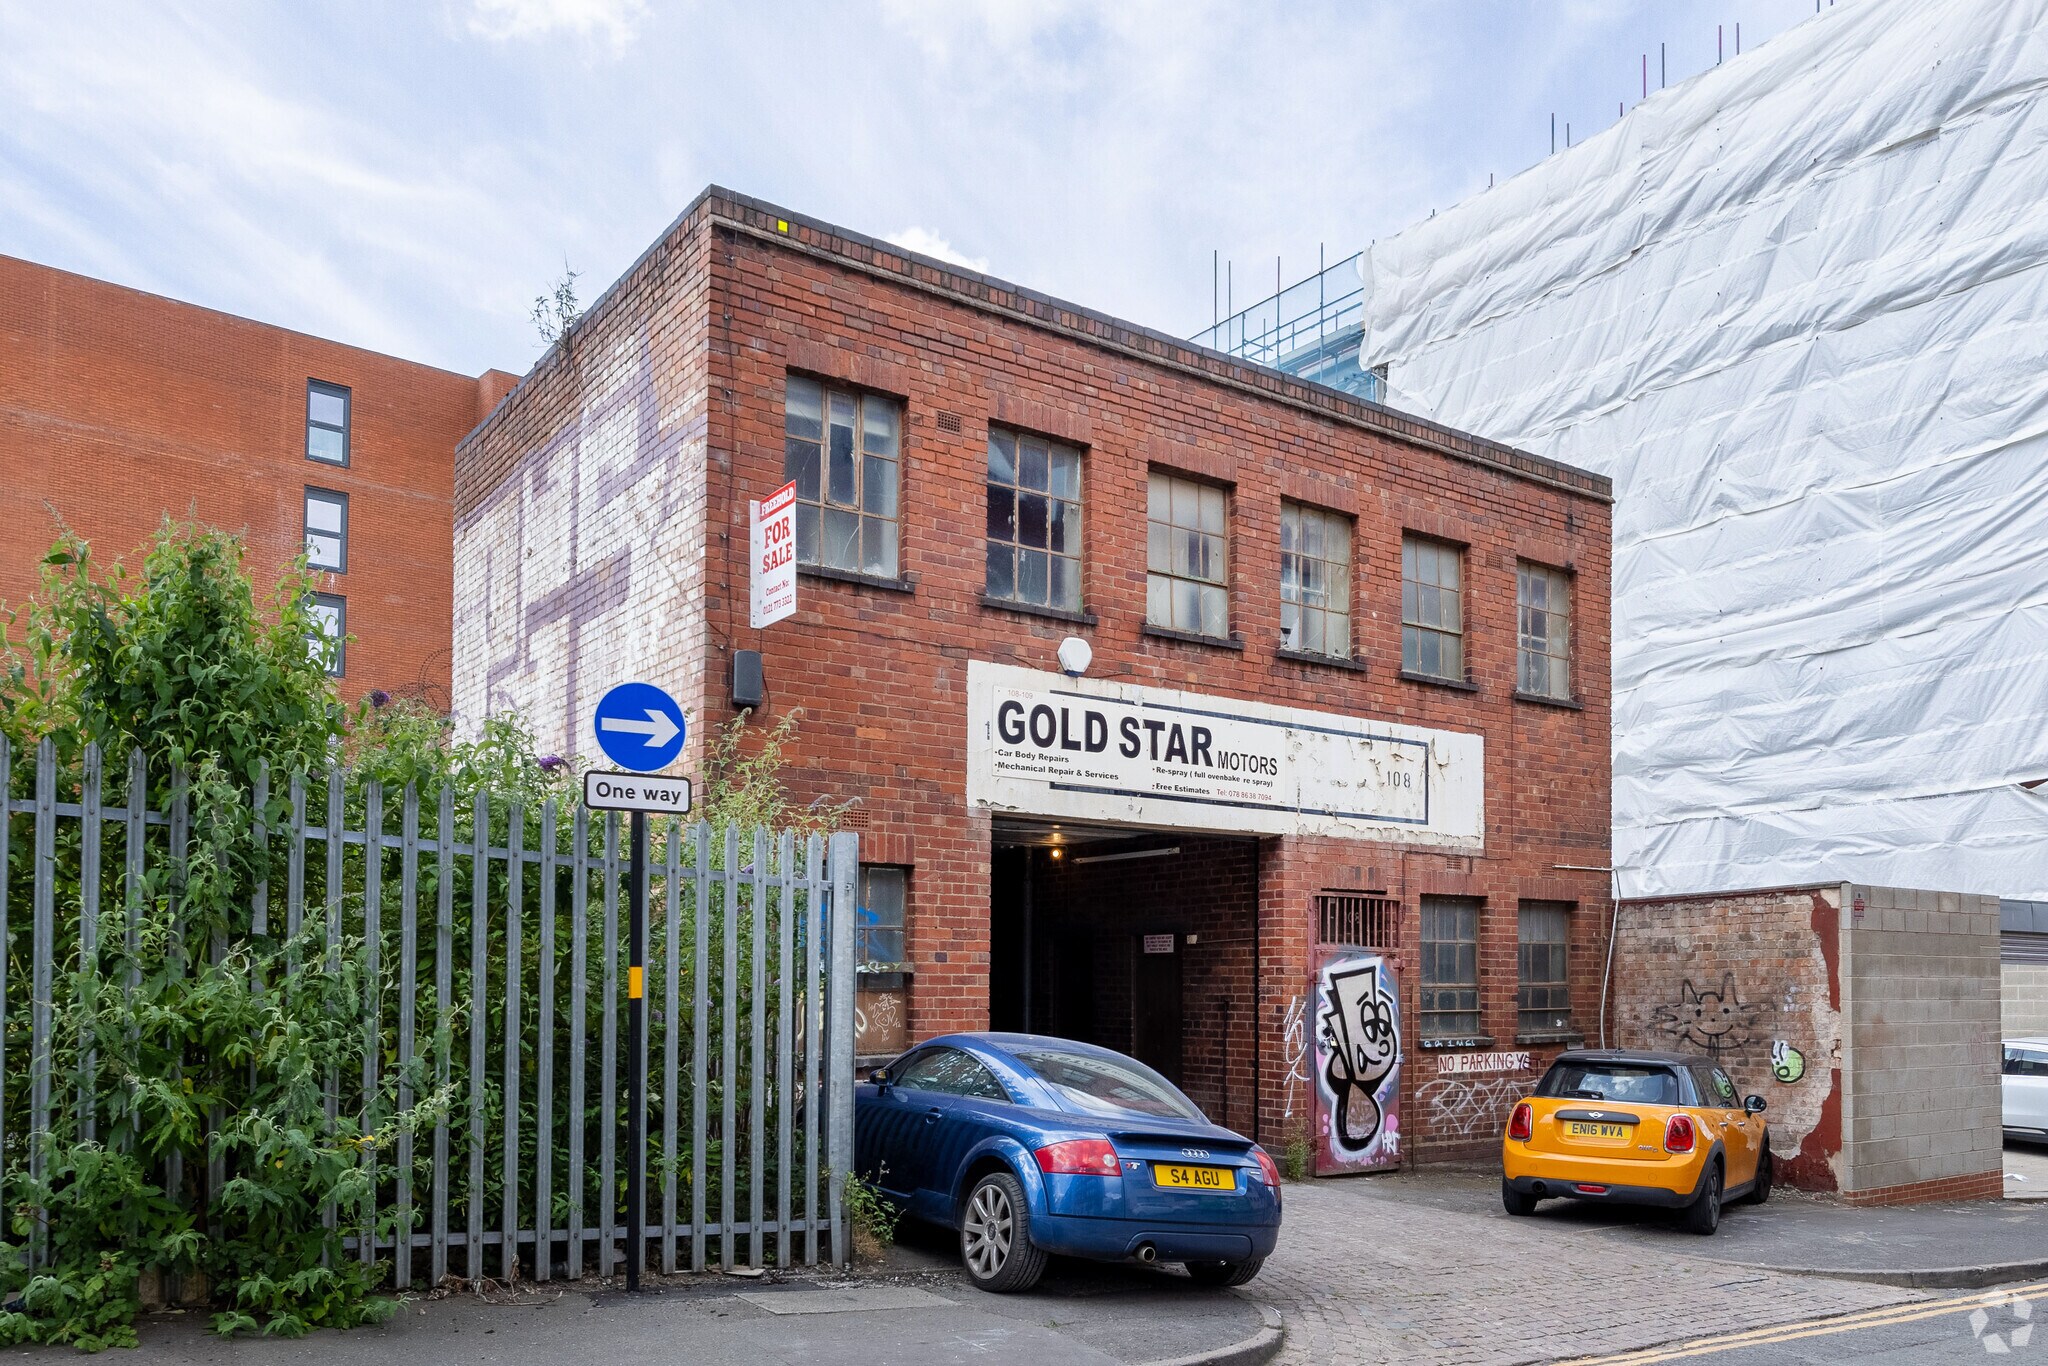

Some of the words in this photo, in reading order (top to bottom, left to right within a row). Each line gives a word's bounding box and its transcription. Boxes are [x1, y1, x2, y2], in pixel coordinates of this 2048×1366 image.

[764, 516, 791, 549] FOR
[762, 542, 793, 574] SALE
[1007, 689, 1034, 700] 108-109
[997, 700, 1109, 753] GOLD
[1118, 716, 1215, 768] STAR
[1217, 750, 1278, 776] MOTORS
[1015, 750, 1036, 761] Body
[1038, 753, 1070, 764] Repairs
[997, 761, 1046, 773] Mechanical
[1048, 766, 1074, 776] Repair
[1076, 769, 1083, 777] &
[1084, 770, 1119, 780] Services
[1155, 766, 1188, 778] Re-spray
[1194, 771, 1206, 779] full
[1207, 773, 1241, 782] ovenbake
[1252, 778, 1273, 788] spray)
[1387, 770, 1411, 788] 108
[596, 781, 636, 799] One
[643, 788, 682, 805] way
[1155, 782, 1172, 791] Free
[1174, 784, 1211, 795] Estimates
[1216, 788, 1228, 797] Tel:
[1228, 790, 1240, 798] 078
[1439, 1055, 1455, 1072] NO
[1460, 1053, 1515, 1070] PARKING
[1571, 1123, 1598, 1135] EN16
[1600, 1125, 1623, 1137] WVA
[1170, 1168, 1189, 1184] S4
[1194, 1168, 1220, 1186] AGU
